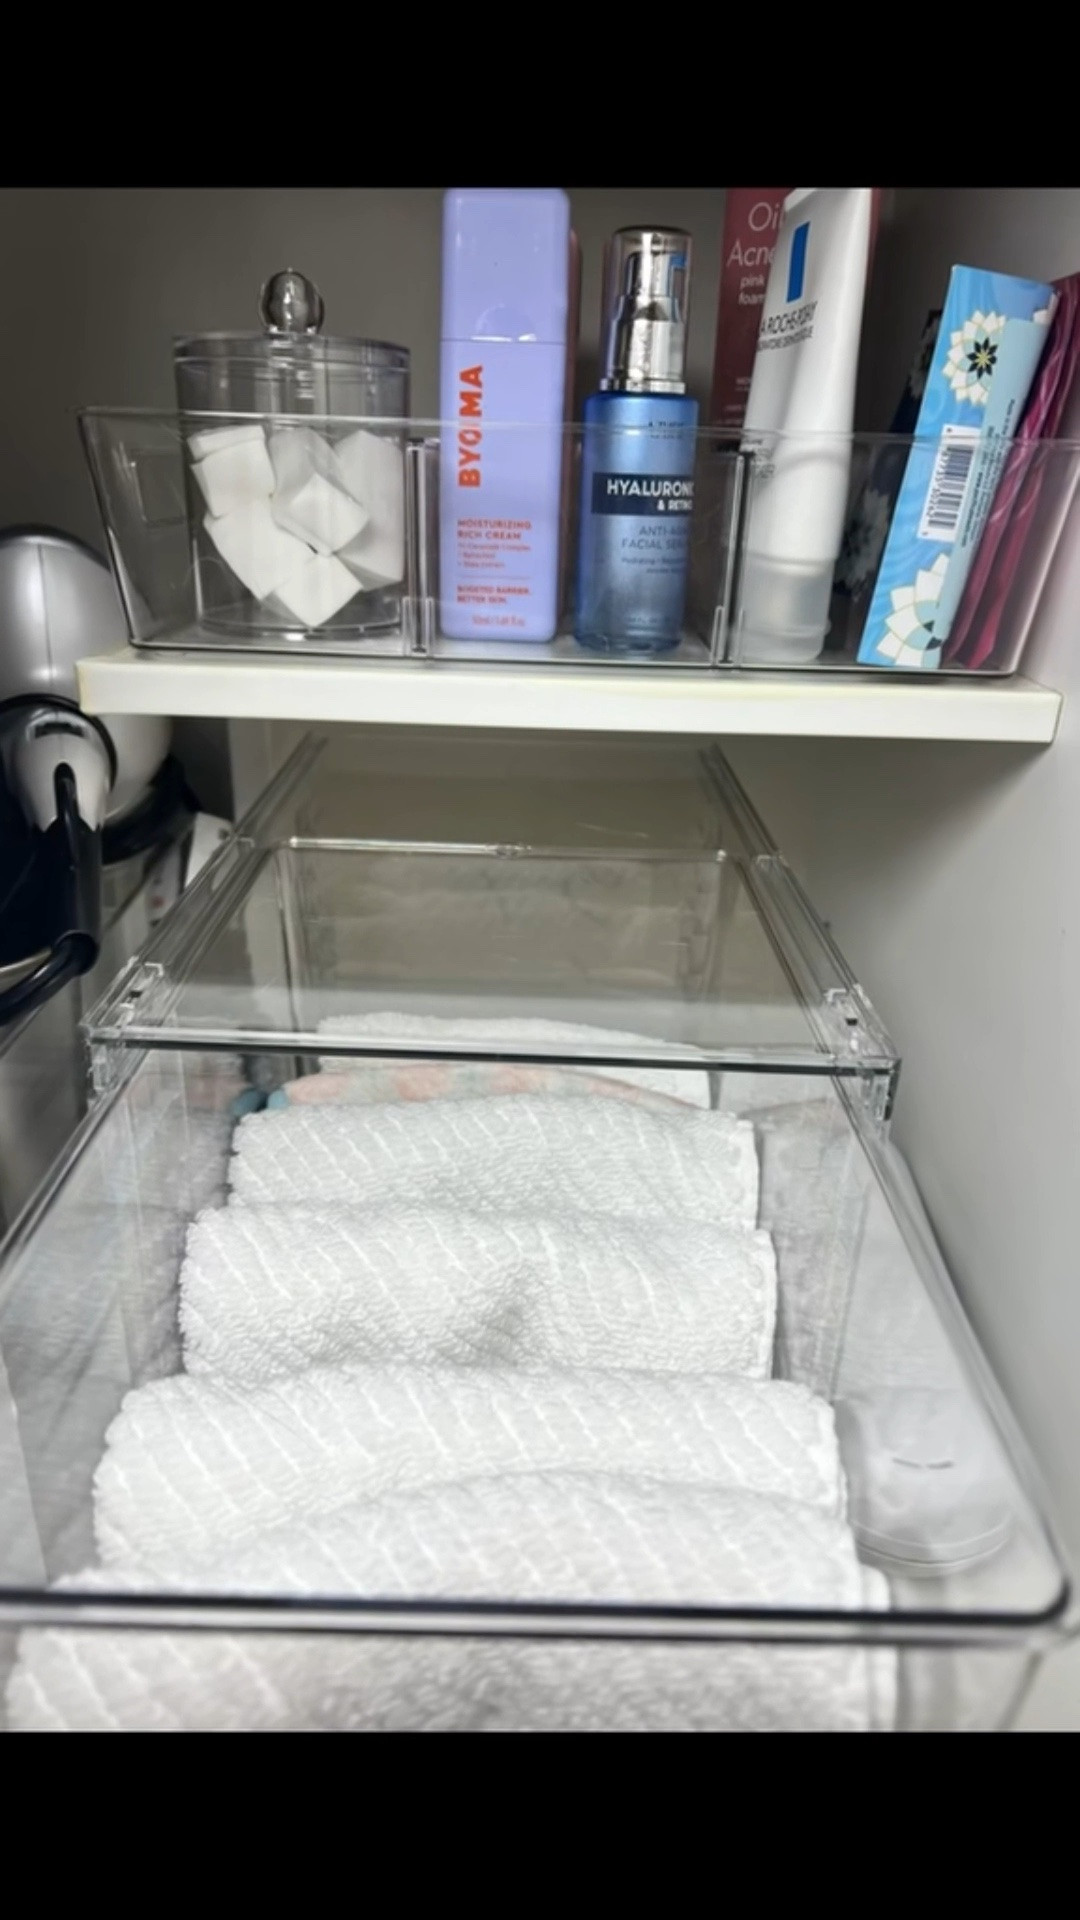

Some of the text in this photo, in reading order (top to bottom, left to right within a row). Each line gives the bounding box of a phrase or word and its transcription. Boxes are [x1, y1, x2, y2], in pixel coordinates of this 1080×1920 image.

[740, 273, 765, 289] pink
[458, 364, 483, 487] BYOMA
[657, 499, 665, 511] &
[457, 518, 532, 531] MOISTURIZING
[457, 529, 522, 542] RICH CREAM
[621, 537, 662, 550] FACIAL
